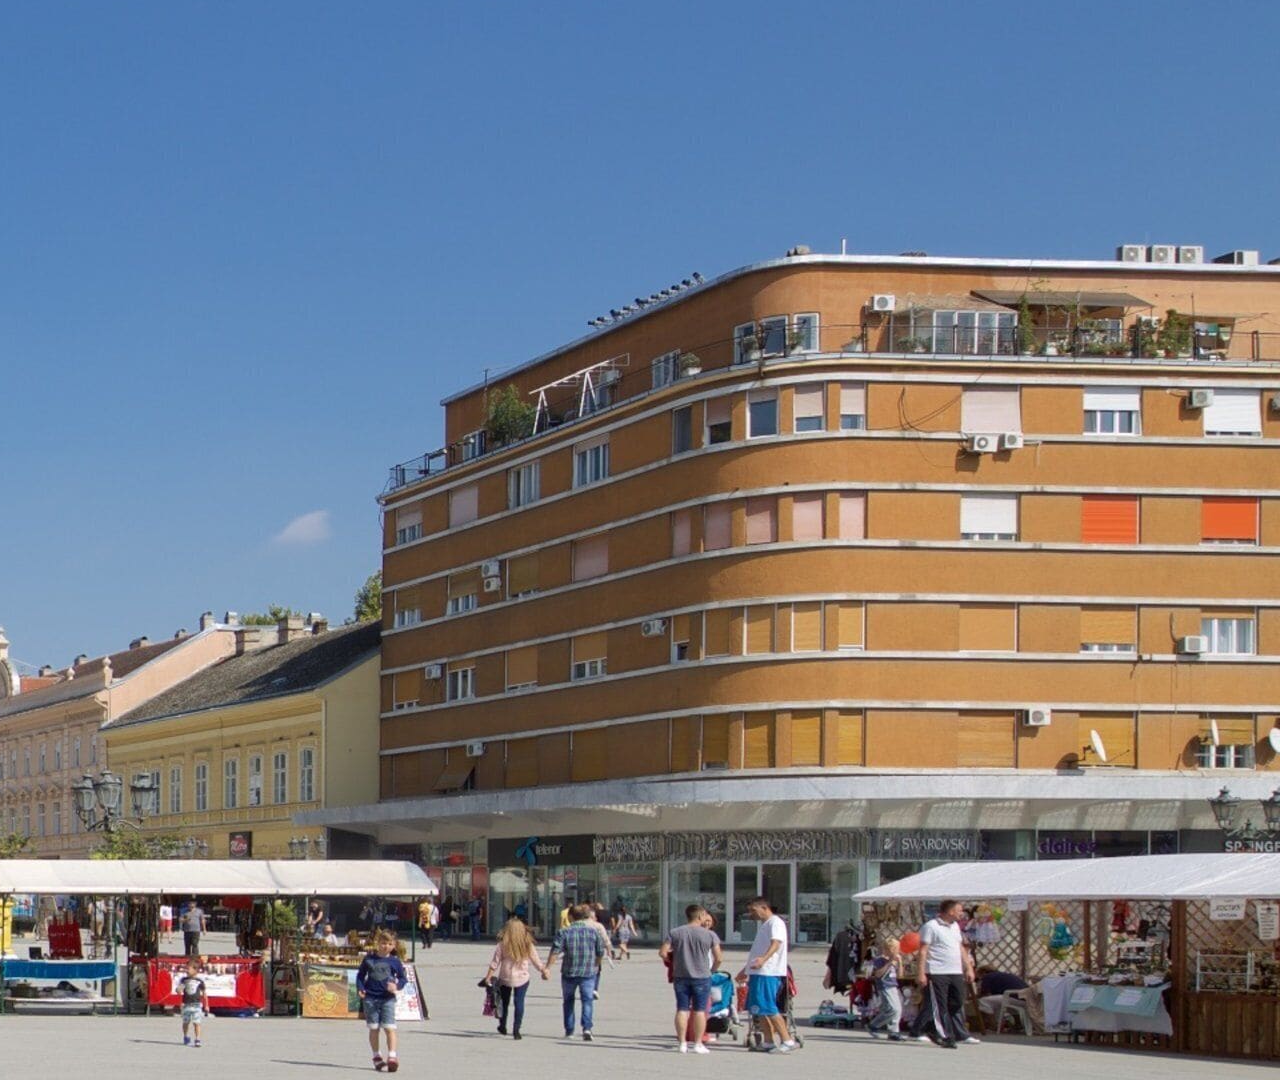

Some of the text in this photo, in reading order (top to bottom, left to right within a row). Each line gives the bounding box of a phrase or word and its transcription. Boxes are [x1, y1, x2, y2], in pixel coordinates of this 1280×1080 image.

[536, 844, 561, 856] telenor
[729, 839, 817, 851] SWAROVSKI
[902, 839, 970, 850] SWAROVSKI
[1225, 840, 1280, 852] SPINGF
